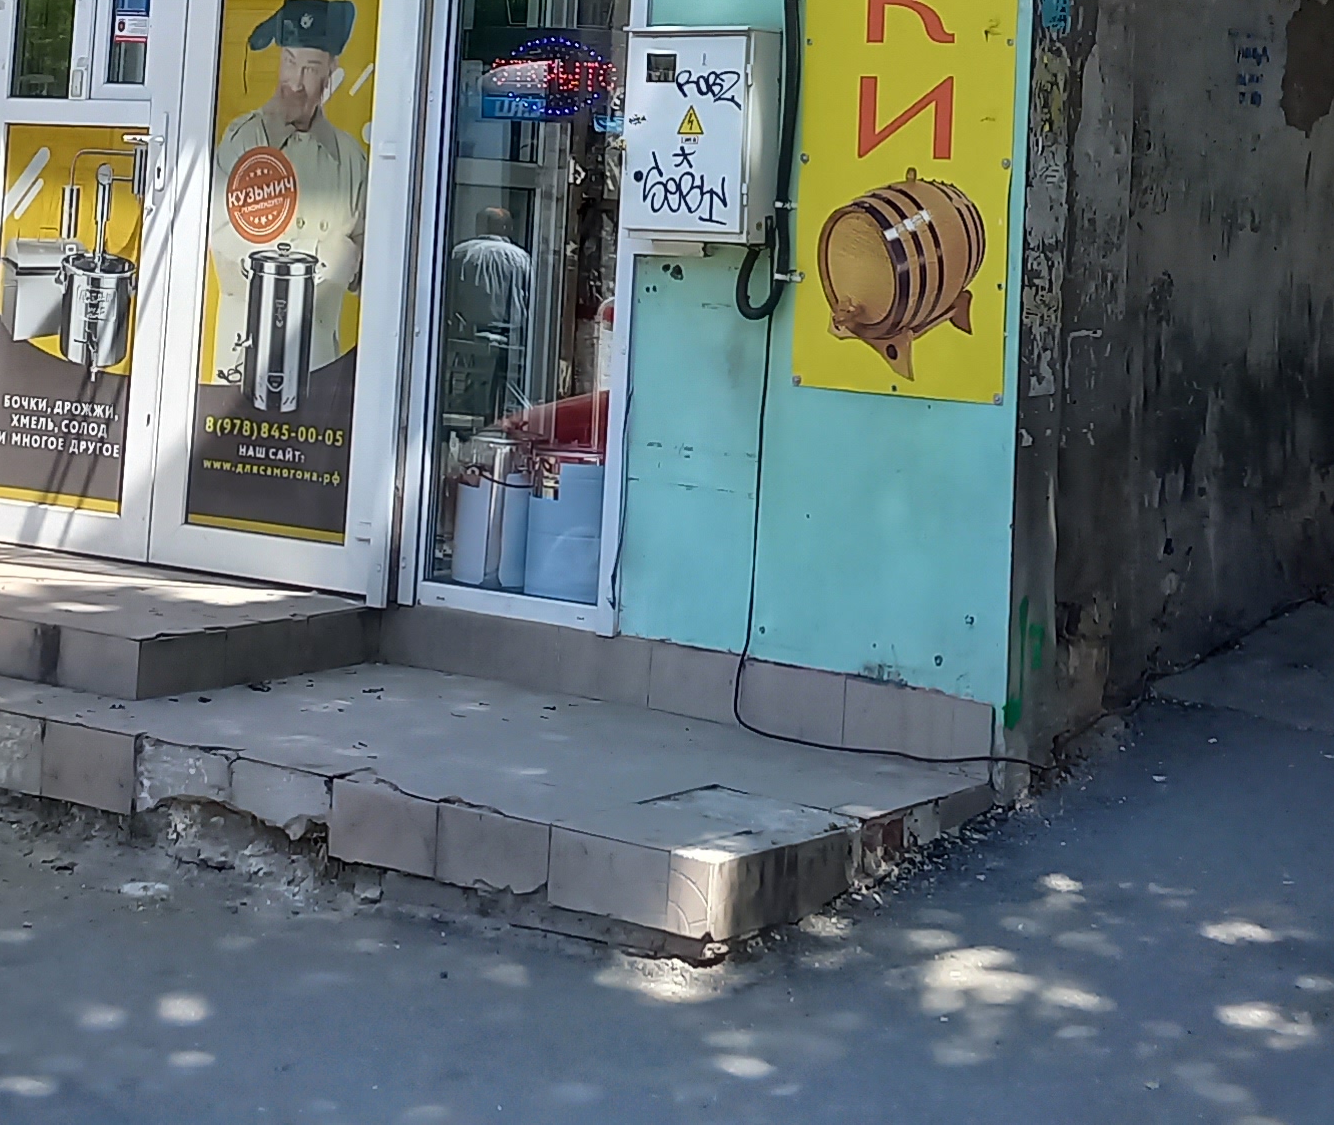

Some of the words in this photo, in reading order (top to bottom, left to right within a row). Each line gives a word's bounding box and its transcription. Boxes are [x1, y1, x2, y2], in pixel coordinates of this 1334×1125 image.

[228, 176, 294, 208] КУЗЬМИЧ
[3, 394, 52, 414] БОЧКИ,
[53, 401, 119, 421] ДРОЖЖИ,
[10, 413, 59, 433] ХМЕЛЬ,
[61, 420, 108, 439] СОЛОД
[205, 416, 344, 447] 8(978)845-00-05
[11, 433, 64, 451] МНОГОЕ
[69, 439, 120, 458] ДРУГОЕ
[238, 444, 266, 458] НАШ
